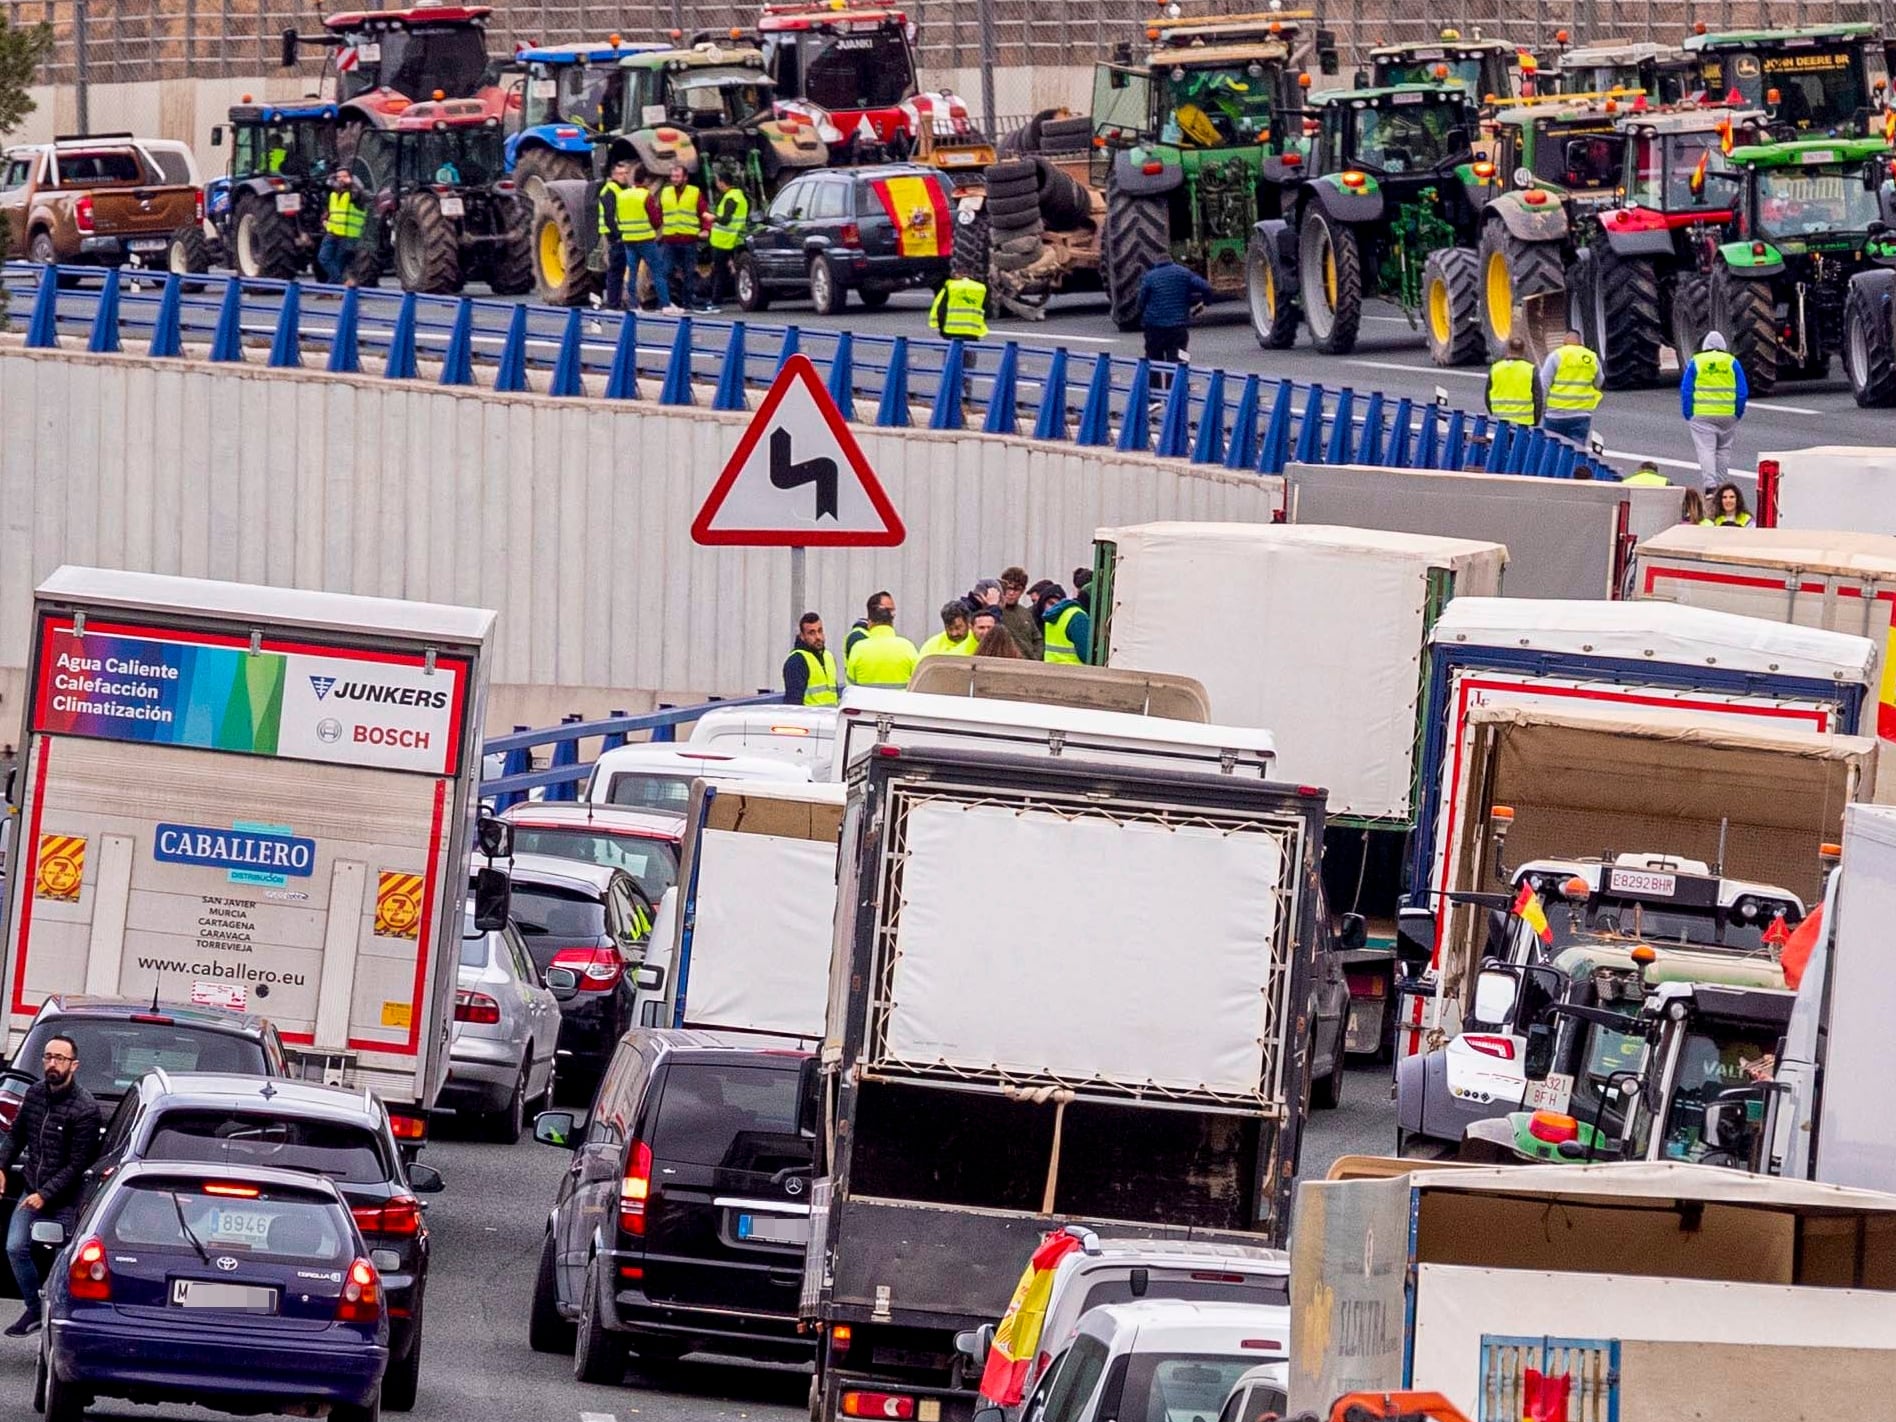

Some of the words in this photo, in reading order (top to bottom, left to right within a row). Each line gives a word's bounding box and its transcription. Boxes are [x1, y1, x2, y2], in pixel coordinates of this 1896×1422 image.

[1796, 55, 1832, 67] DEERE
[57, 653, 101, 672] Agua
[105, 658, 179, 680] Caliente
[55, 674, 159, 699] Calefacción
[334, 682, 448, 709] JUNKERS
[53, 695, 173, 723] Climatización
[353, 724, 430, 749] BOSCH
[160, 831, 310, 868] CABALLERO
[202, 896, 222, 905] SAN
[224, 899, 256, 909] JAVIER
[209, 908, 247, 919] MURCIA
[198, 918, 255, 931] CARTAGENA
[200, 929, 251, 942] CARAVACA
[196, 940, 253, 953] TORREVIEJA
[138, 957, 305, 985] www.caballero.eu
[223, 1215, 266, 1233] 8946
